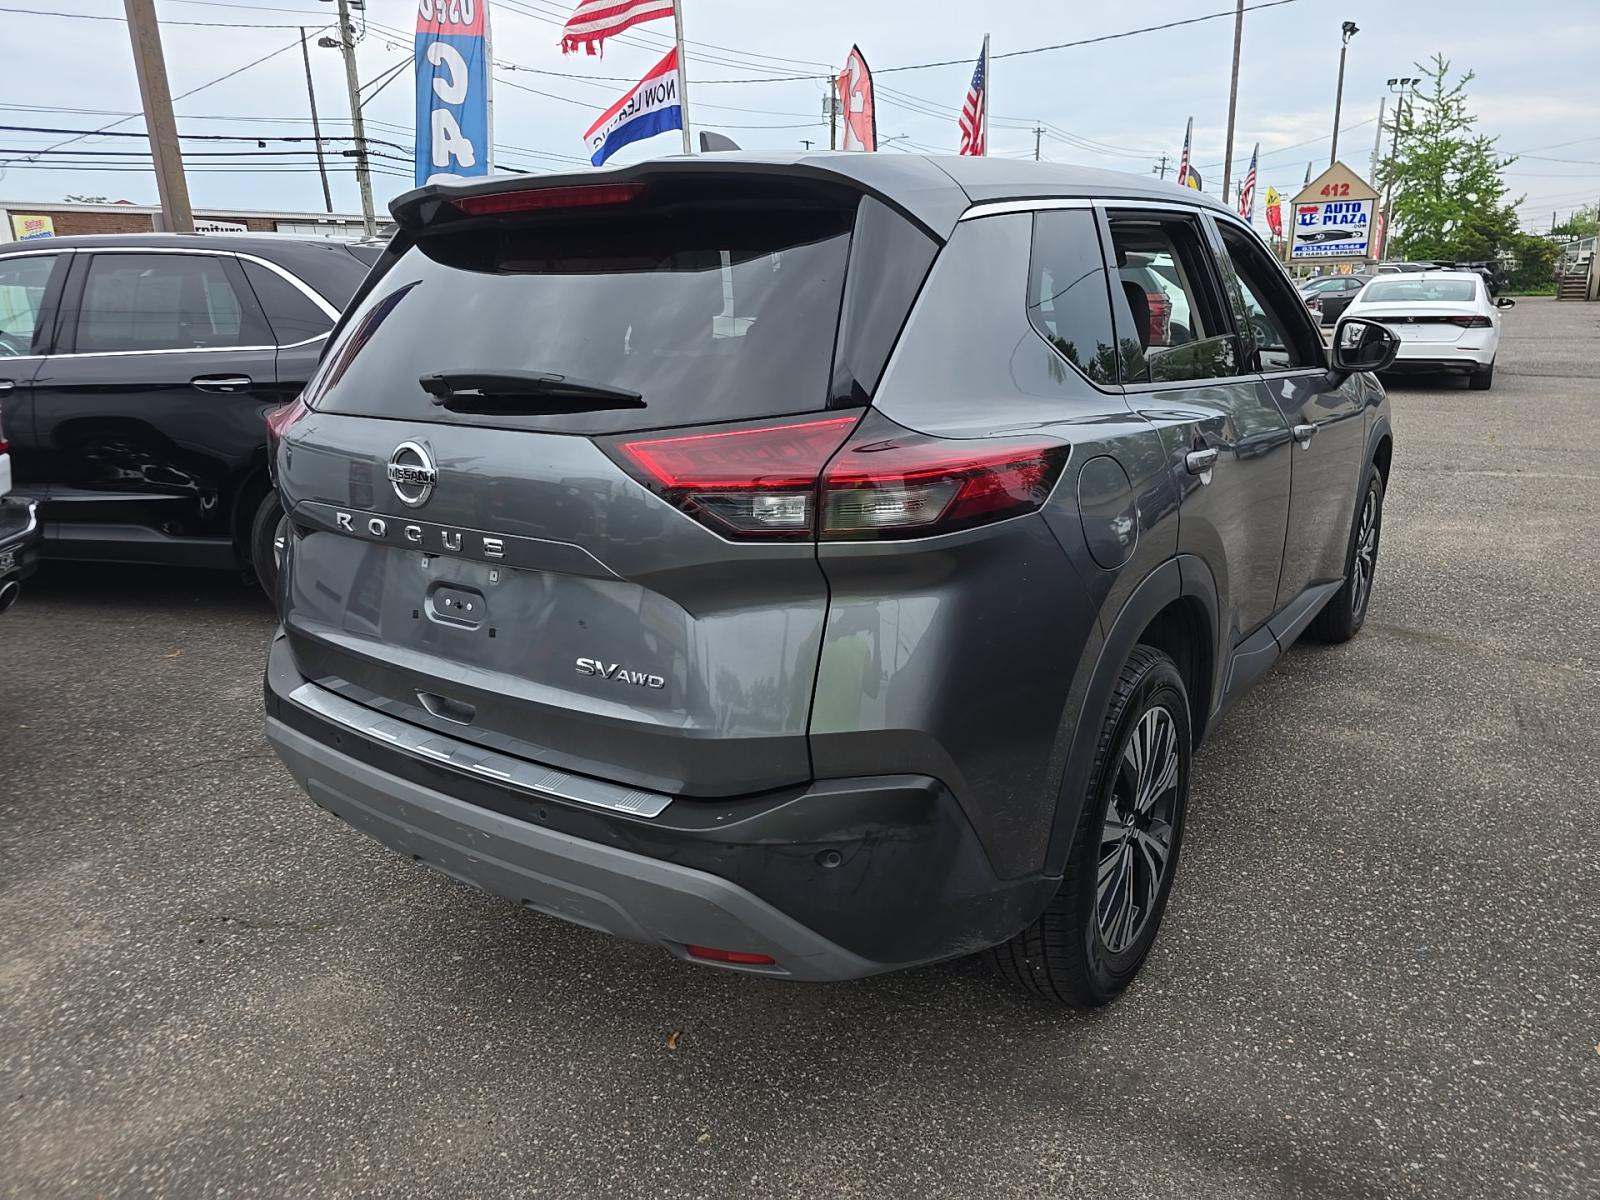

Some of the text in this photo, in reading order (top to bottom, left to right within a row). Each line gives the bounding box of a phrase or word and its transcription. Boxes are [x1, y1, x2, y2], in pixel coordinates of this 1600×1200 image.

[1320, 183, 1350, 197] 412
[1324, 202, 1361, 214] AUTO
[1322, 213, 1367, 226] PLAZA
[388, 466, 436, 484] NISSAN
[337, 512, 506, 558] ROGUE
[575, 657, 665, 689] SV AWD
